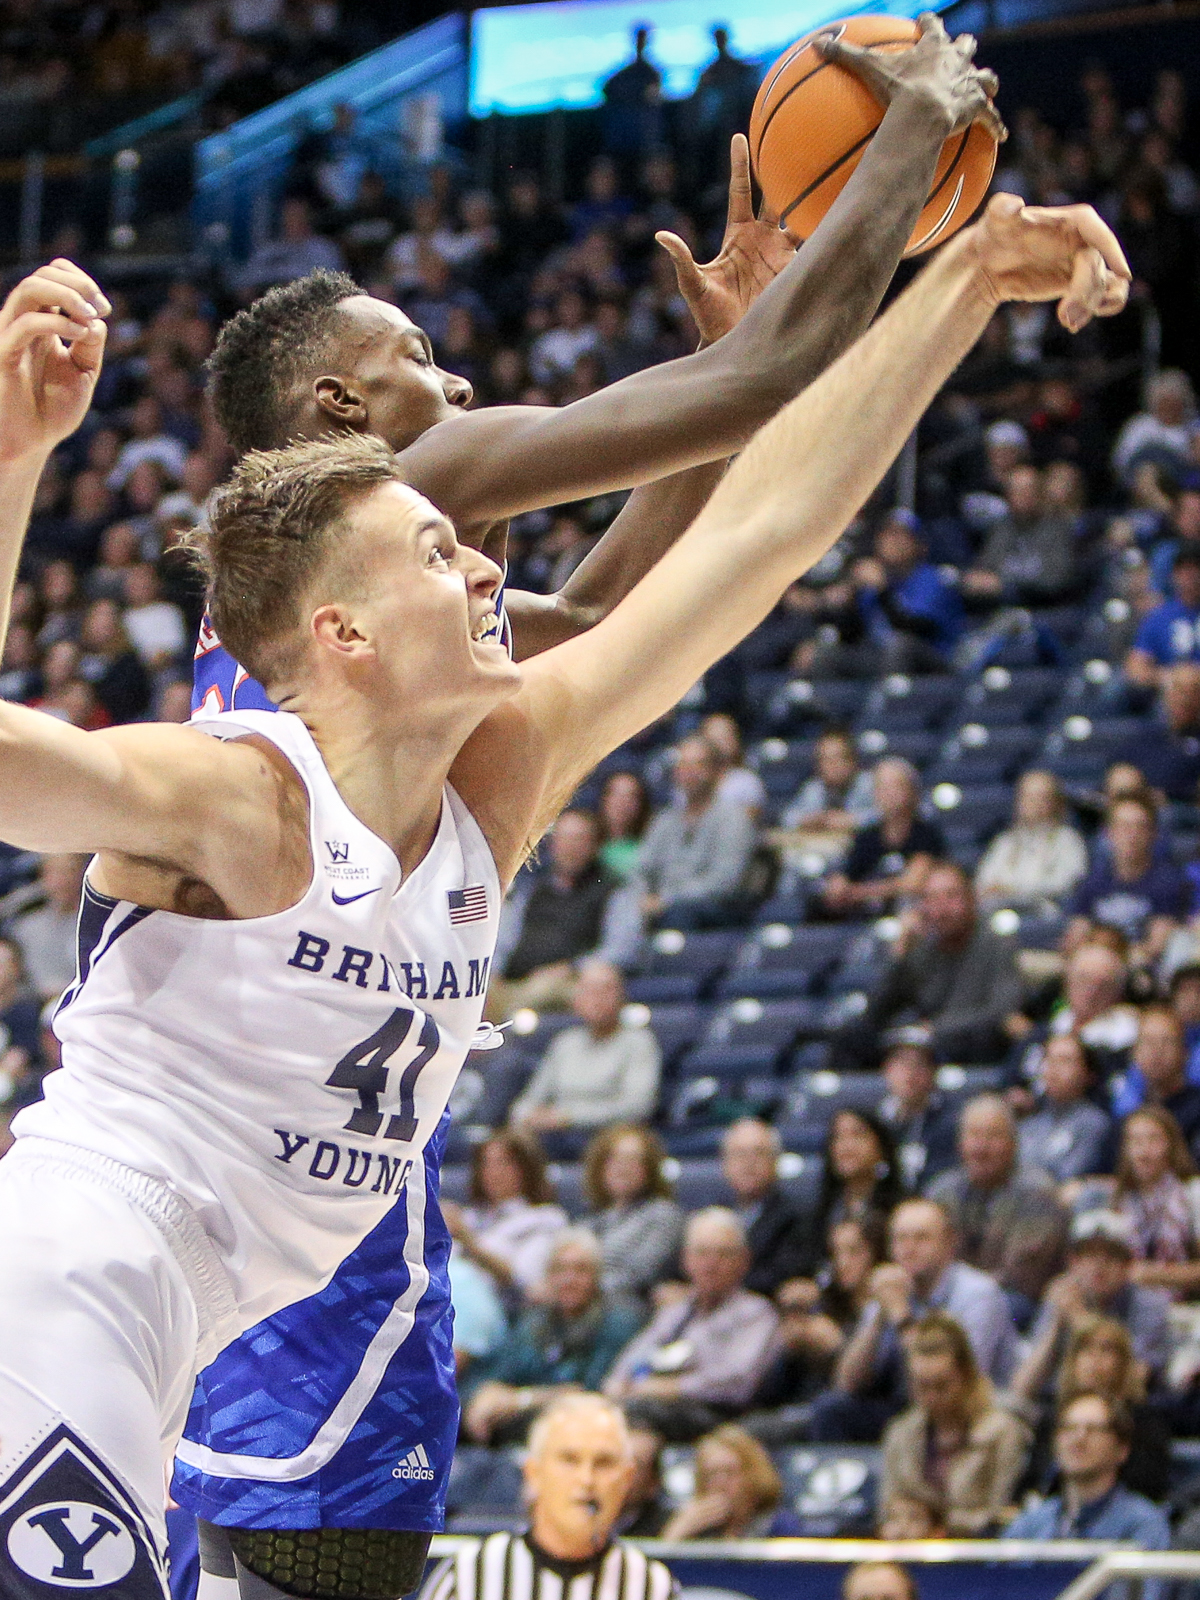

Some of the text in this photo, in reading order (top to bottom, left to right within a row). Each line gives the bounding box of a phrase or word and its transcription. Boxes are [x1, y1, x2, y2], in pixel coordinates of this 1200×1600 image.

[343, 867, 370, 875] COAST
[287, 930, 490, 1000] BRIHAM
[325, 1007, 440, 1142] 41
[392, 1466, 435, 1480] adidas
[27, 1507, 122, 1580] Y
